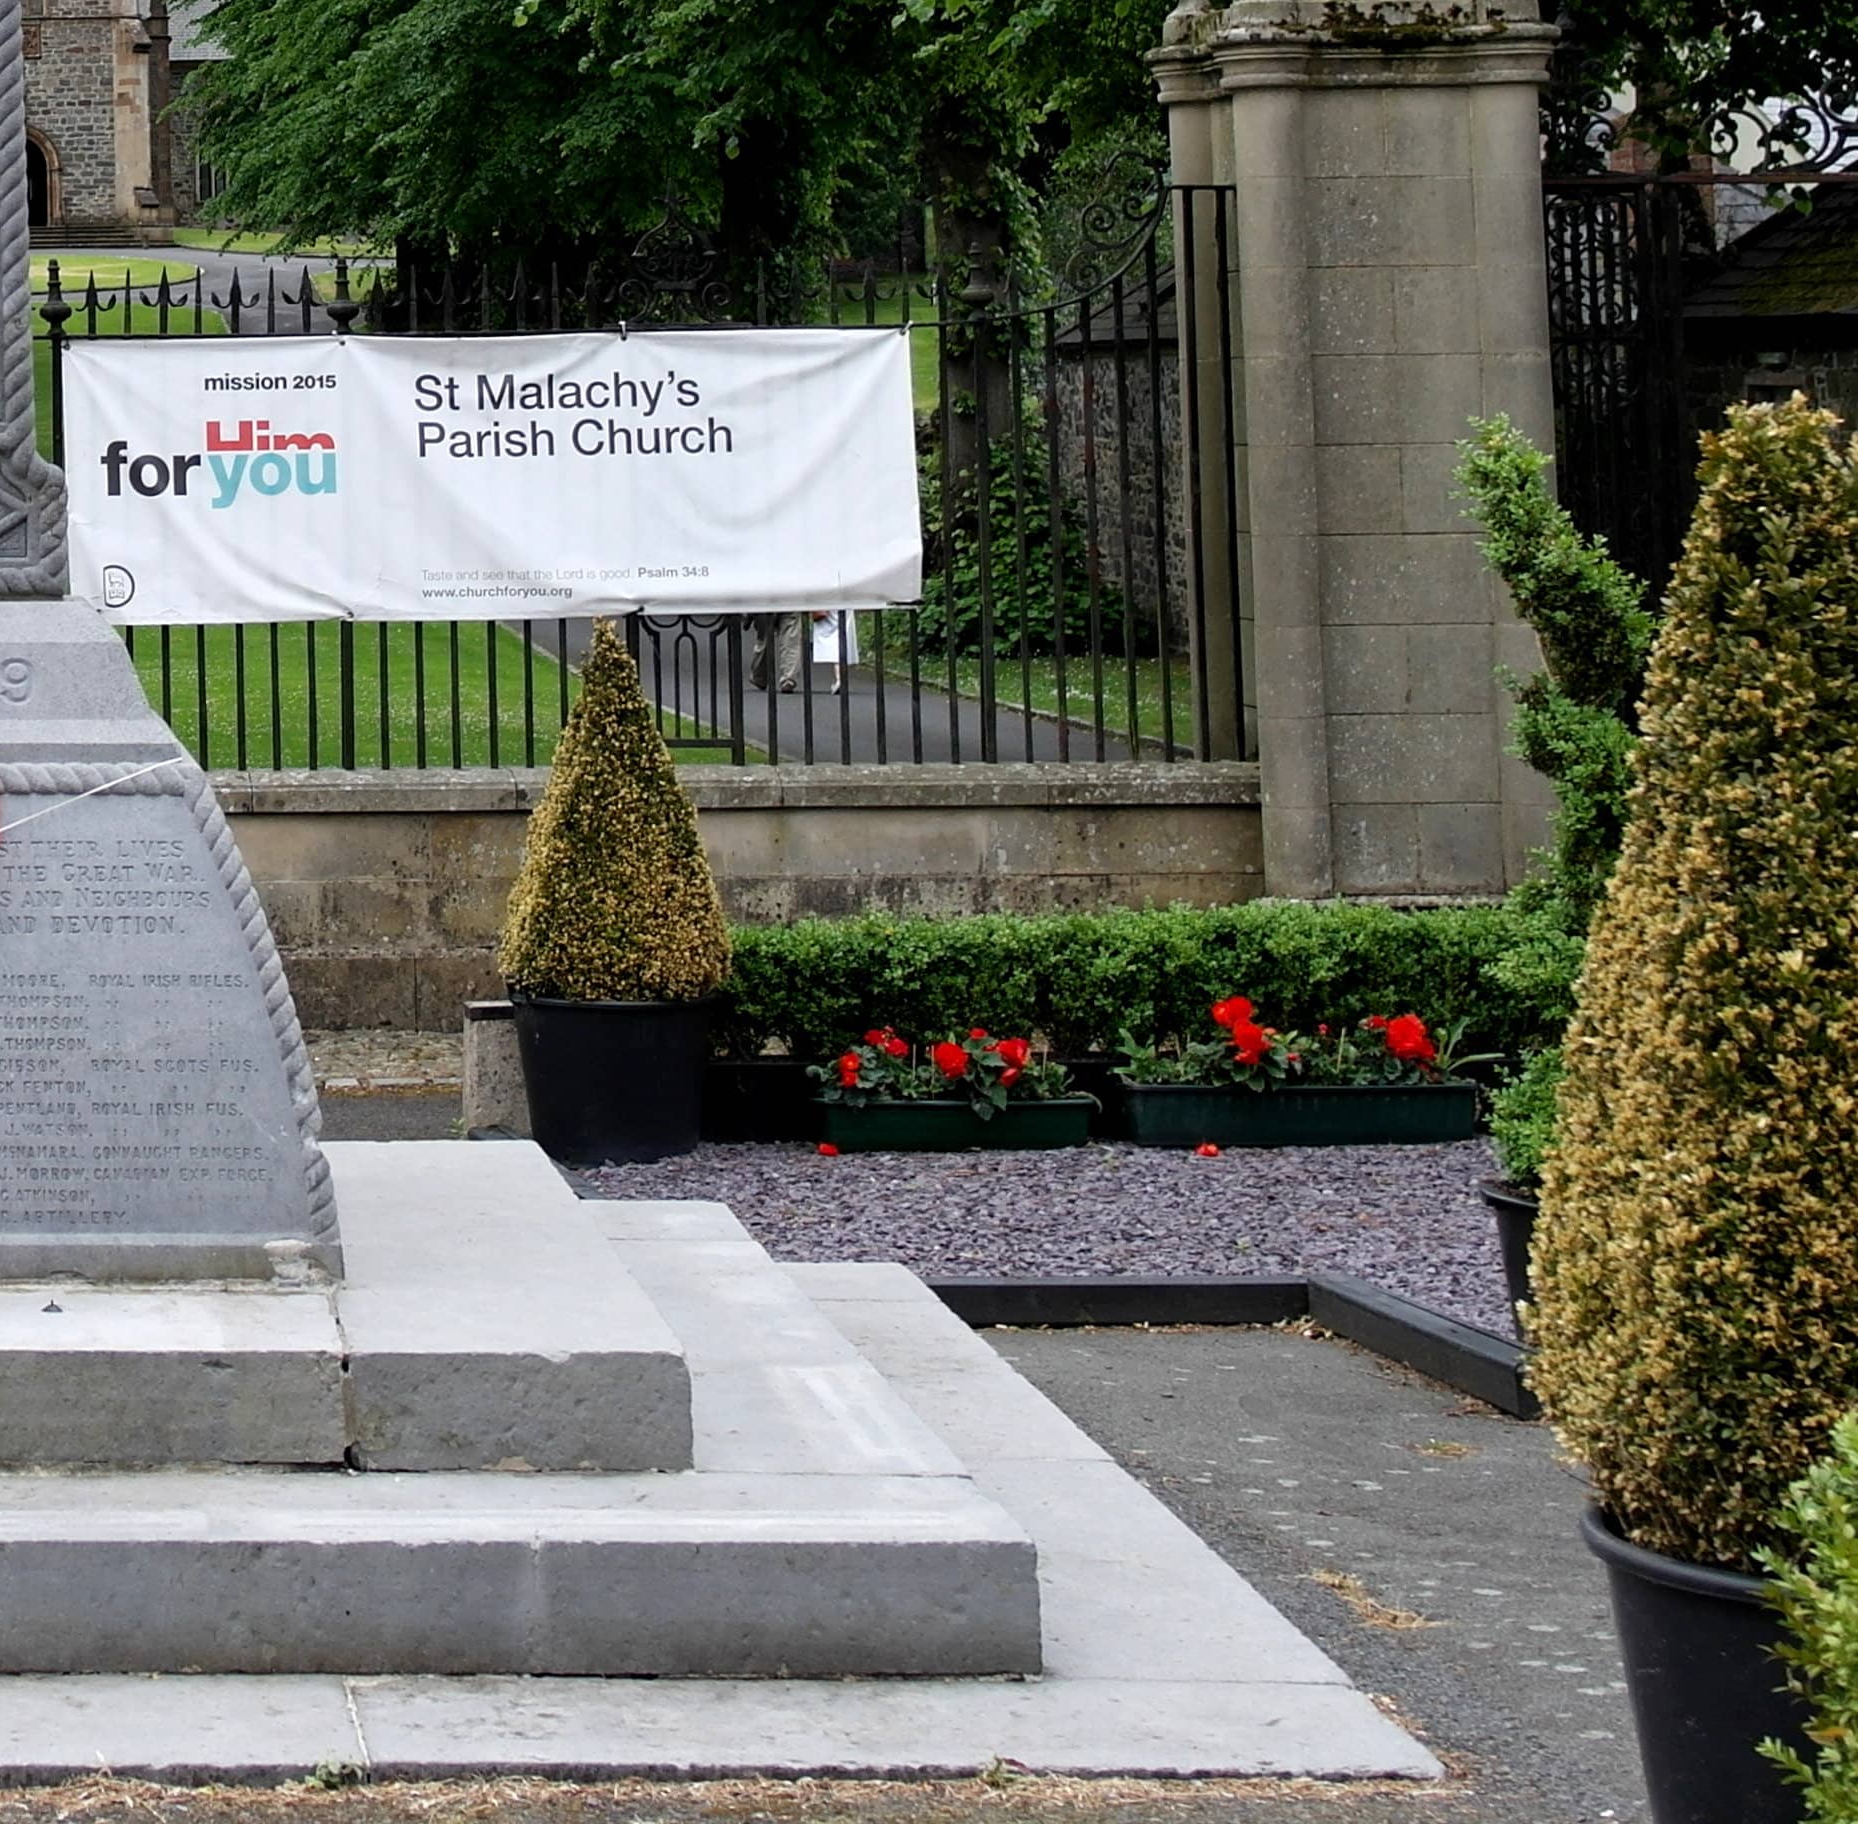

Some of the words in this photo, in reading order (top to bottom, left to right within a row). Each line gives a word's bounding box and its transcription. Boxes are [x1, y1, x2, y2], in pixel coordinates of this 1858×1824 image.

[204, 373, 287, 391] mission
[293, 375, 337, 390] 2015
[414, 374, 461, 411] St
[476, 370, 701, 417] Malachy's
[417, 419, 555, 458] Parish
[571, 416, 733, 456] Church
[421, 569, 453, 581] Taste
[455, 569, 479, 581] and
[482, 571, 504, 581] see
[507, 569, 531, 581] that
[533, 568, 553, 580] the
[555, 567, 584, 580] Lord
[586, 568, 597, 579] is
[637, 566, 679, 578] Psalm
[682, 565, 710, 578] 34:8
[421, 586, 573, 599] www.churchforyou.org
[30, 840, 104, 858] THEIR
[115, 840, 185, 858] LIVES
[2, 865, 47, 882] THE
[61, 863, 135, 883] GREAT
[21, 890, 64, 908] AND
[74, 887, 212, 909] NEIGHBOURS
[49, 915, 186, 935] DEVOTION.
[88, 973, 135, 988] ROYAL
[142, 973, 181, 988] IRISH
[189, 973, 250, 988] RIFLES.
[90, 1058, 145, 1073] ROYAL
[153, 1059, 209, 1073] SCOTS
[219, 1059, 260, 1073] FUS.
[91, 1101, 143, 1117] ROYAL
[149, 1101, 196, 1117] IRISH
[205, 1101, 245, 1116] FUS.
[92, 1145, 182, 1160] CONNAUGHT
[189, 1146, 270, 1161] RANGERS.
